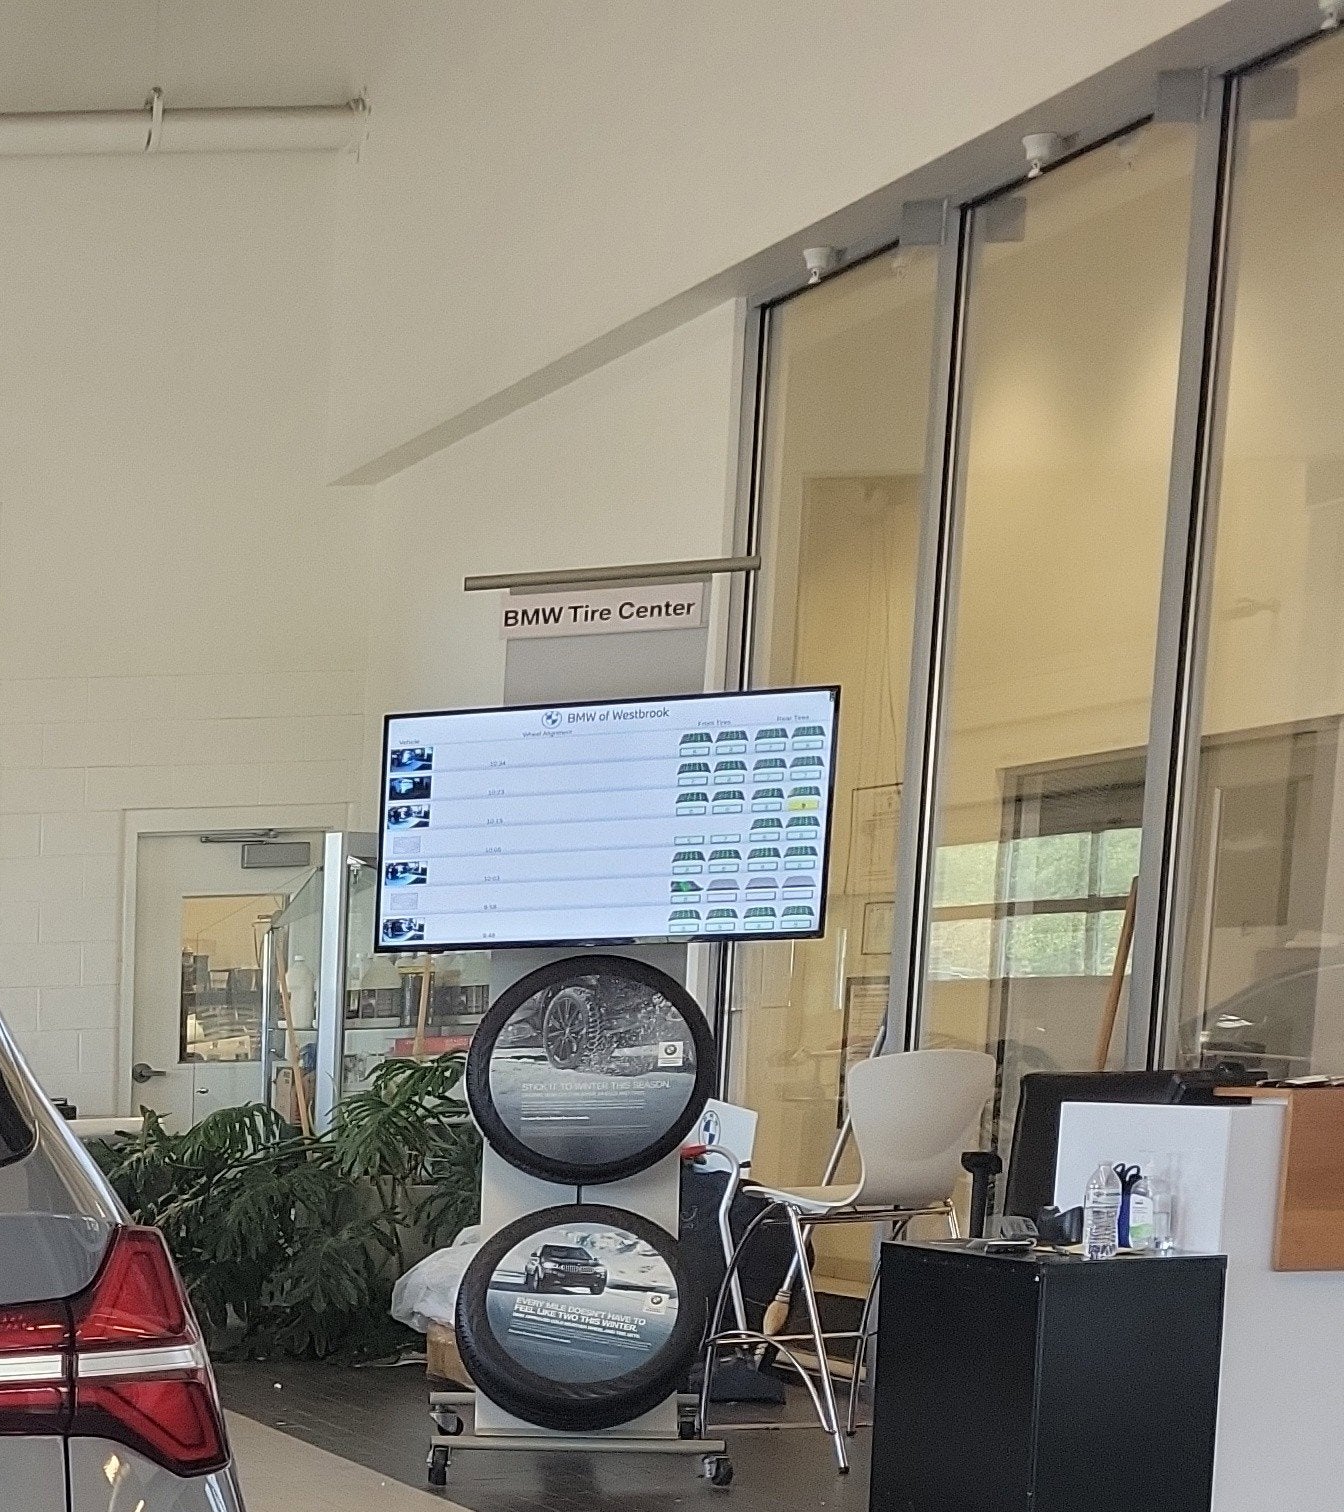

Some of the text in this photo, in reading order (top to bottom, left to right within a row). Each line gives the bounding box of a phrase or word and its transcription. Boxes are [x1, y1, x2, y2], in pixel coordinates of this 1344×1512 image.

[503, 600, 696, 627] BMW Tire Center
[567, 706, 670, 724] BMW of Westbrook
[514, 1304, 536, 1314] FEEL
[559, 1312, 579, 1321] TWO
[580, 1315, 601, 1325] THIS
[633, 1317, 646, 1326] TO
